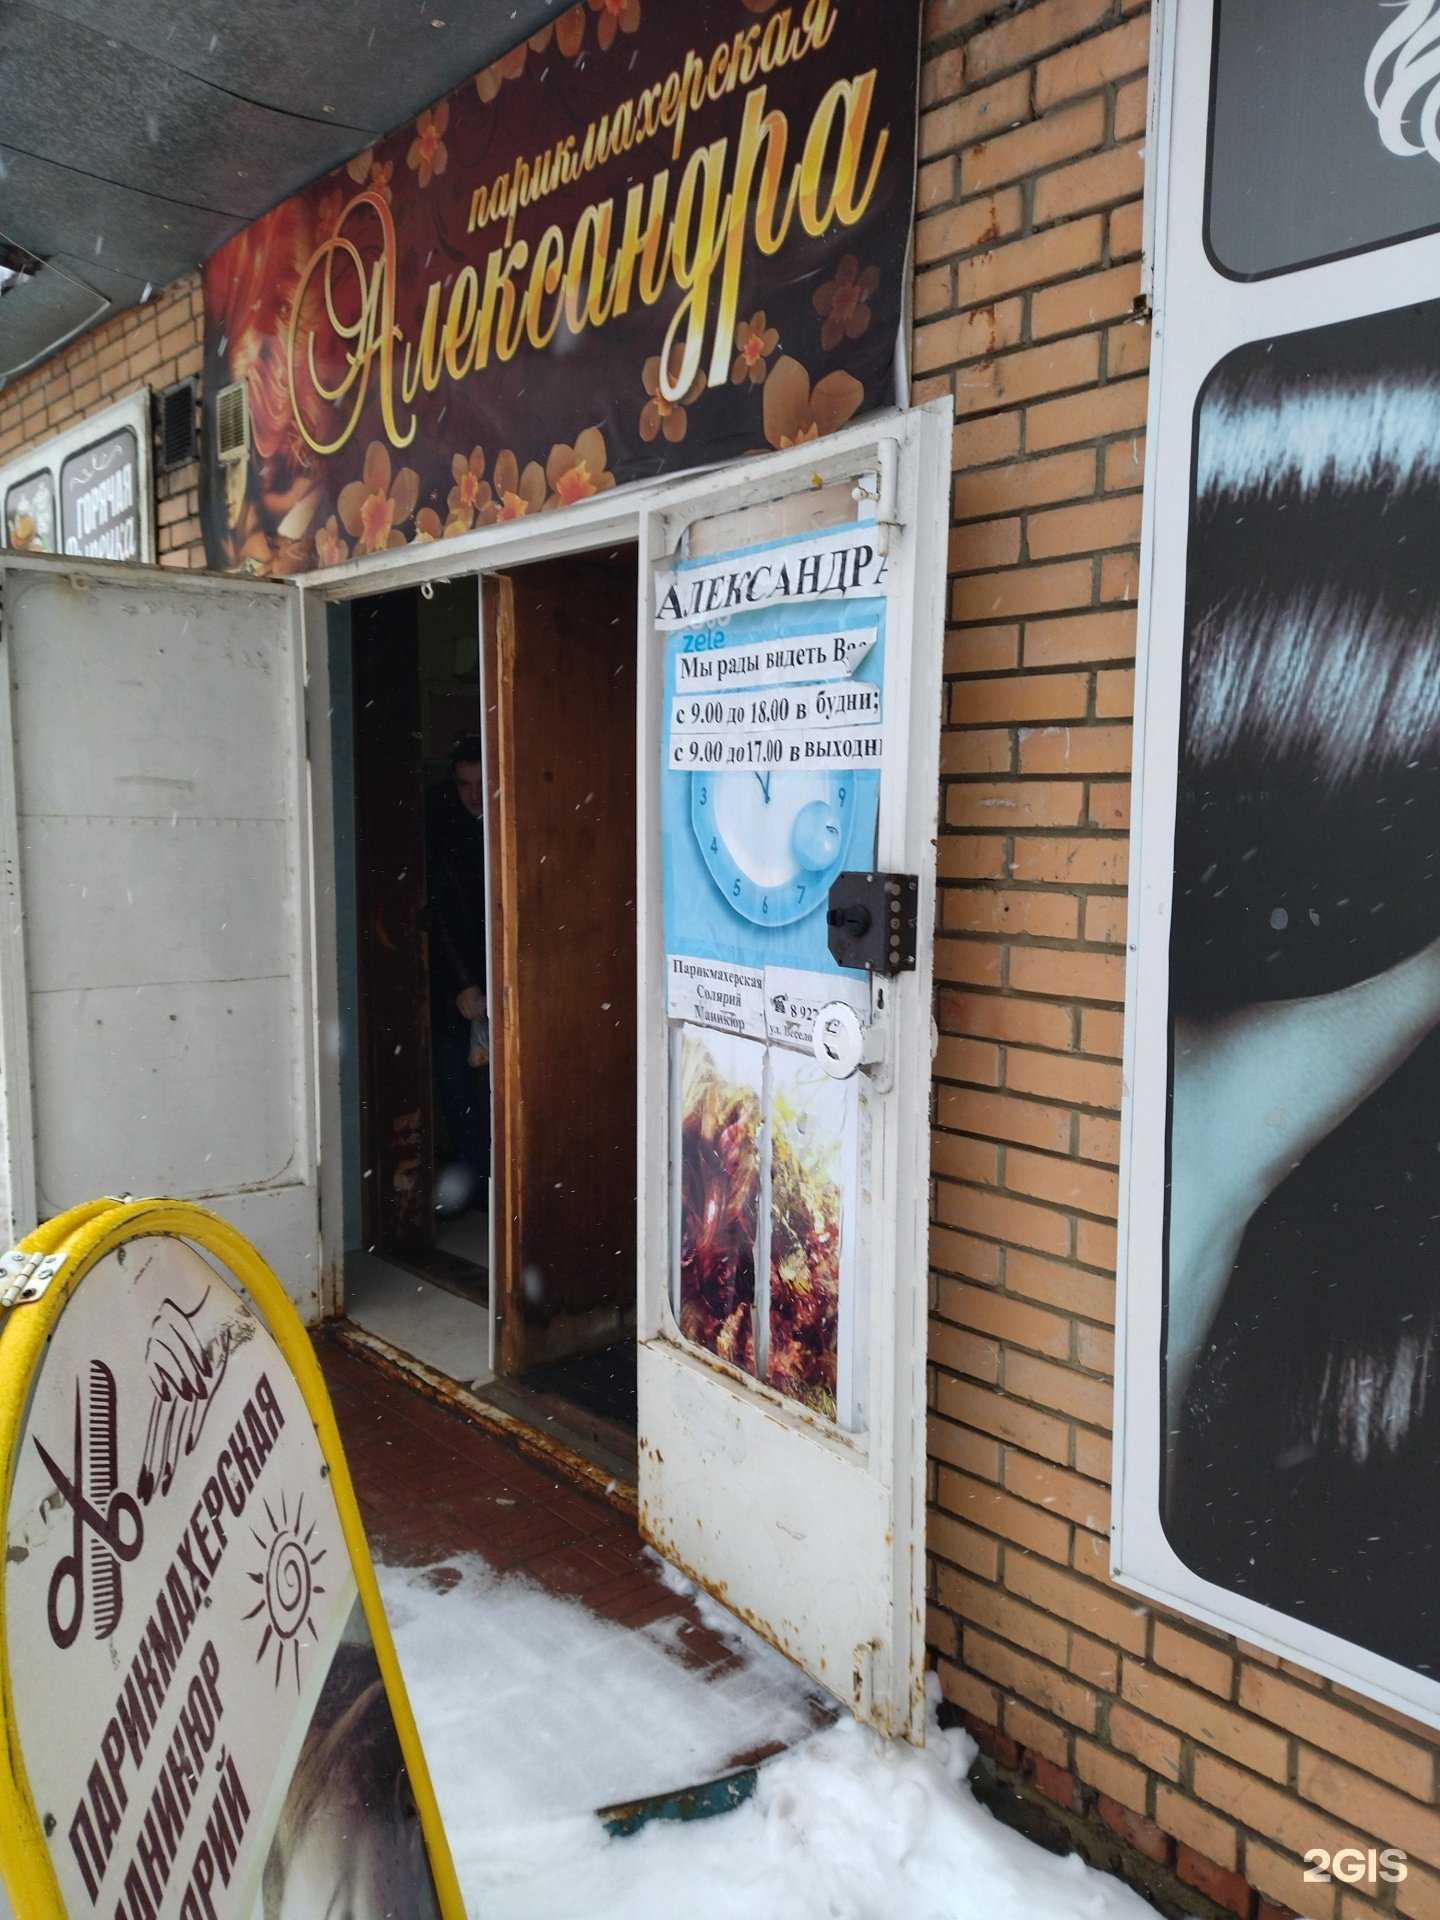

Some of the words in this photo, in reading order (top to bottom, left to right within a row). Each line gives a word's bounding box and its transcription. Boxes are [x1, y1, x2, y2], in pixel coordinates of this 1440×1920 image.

[467, 0, 838, 248] парикмахерская
[288, 68, 890, 454] Александра
[680, 657, 713, 680] Мы
[717, 655, 760, 681] рады
[766, 647, 827, 670] видеть
[676, 709, 685, 724] с
[691, 702, 723, 723] 9.00
[727, 706, 745, 725] до
[751, 698, 789, 723] 18.00
[796, 703, 807, 719] в
[674, 746, 683, 762] с
[689, 741, 723, 762] 9.00
[790, 745, 800, 761] в
[804, 739, 882, 760] выходн
[673, 959, 762, 990] Парикмахерская
[696, 983, 741, 1007] Солярий
[68, 1371, 285, 1908] ПАРИКМАХЕРСКАЯ
[114, 1639, 224, 1920] АНИКЮР
